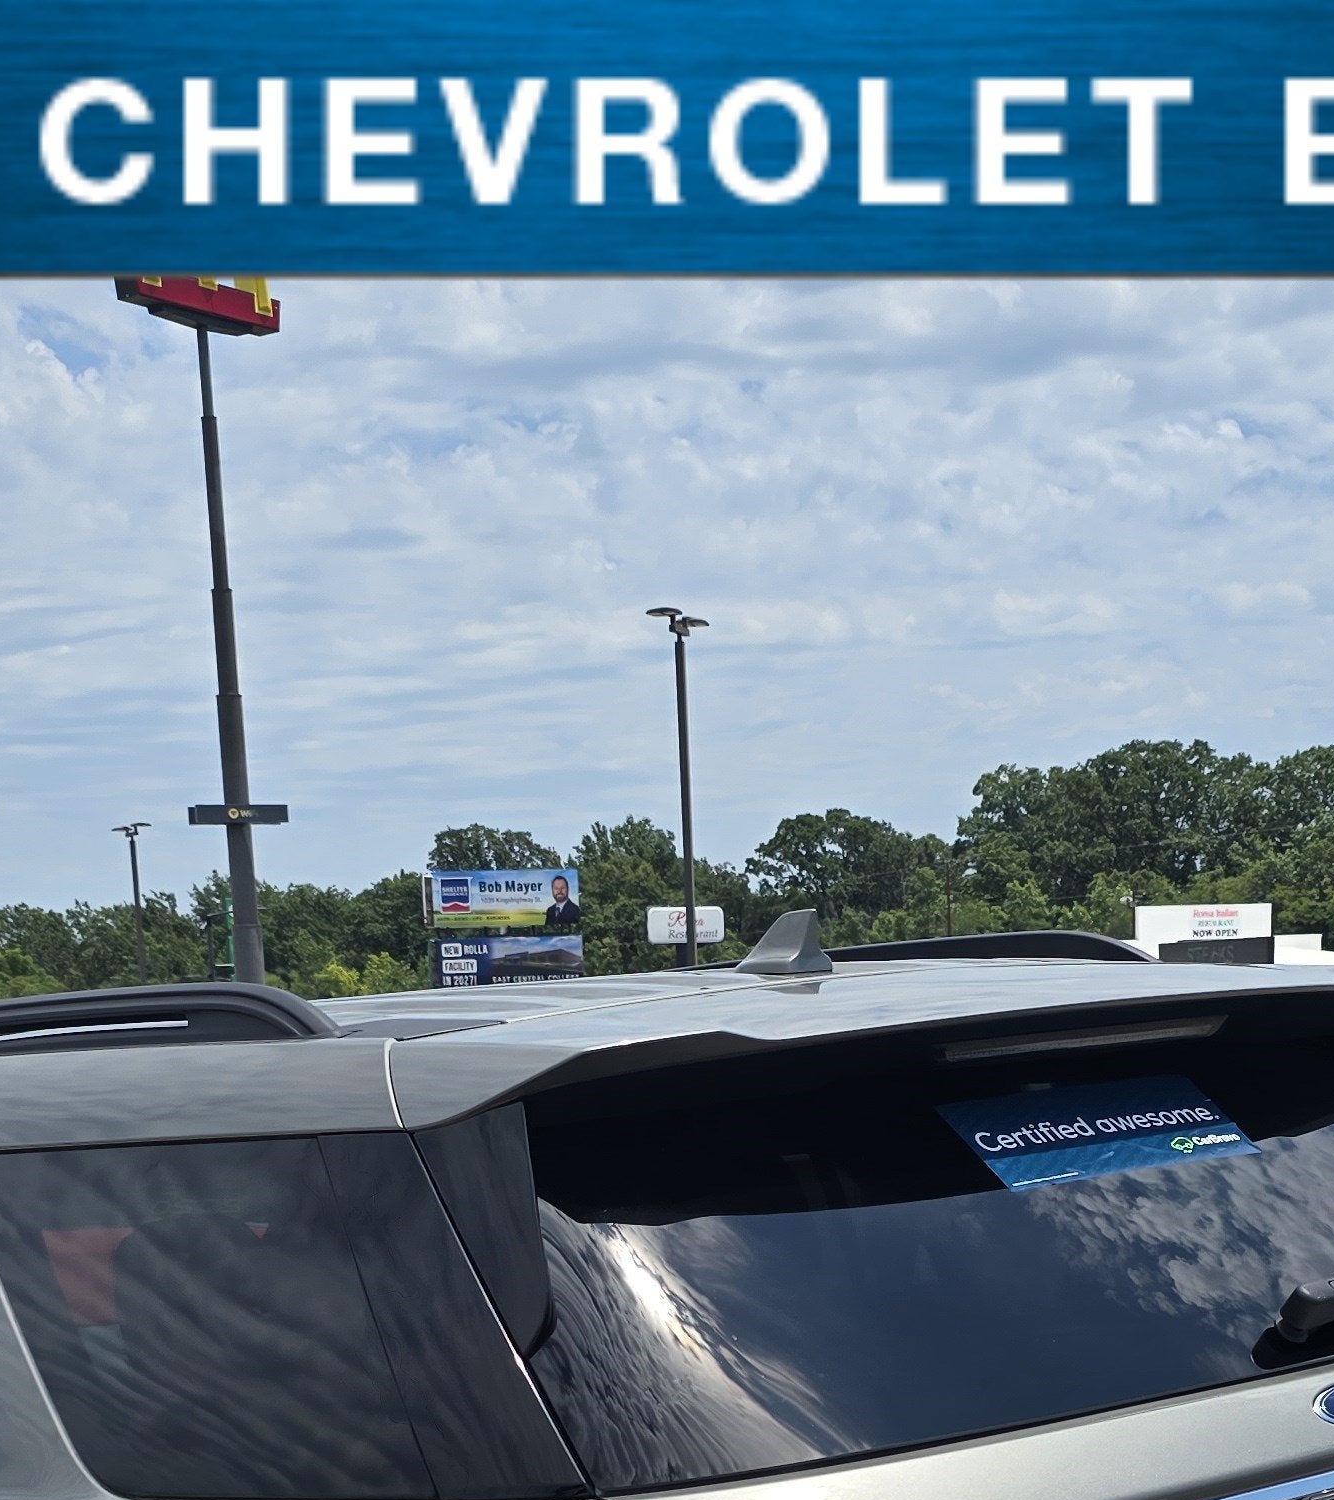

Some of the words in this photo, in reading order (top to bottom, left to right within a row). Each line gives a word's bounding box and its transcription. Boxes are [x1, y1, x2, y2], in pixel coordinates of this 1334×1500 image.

[441, 885, 468, 893] SHELTER
[478, 880, 502, 893] Bob
[505, 879, 543, 895] Mayer
[1192, 929, 1213, 938] NOW
[1215, 928, 1239, 937] OPEN
[443, 945, 461, 955] NEW
[463, 944, 489, 955] ROLLA
[444, 961, 476, 972] FACILITY
[492, 975, 512, 984] EAST
[513, 974, 545, 983] CENTRAL
[973, 1116, 1096, 1154] Certified
[1096, 1104, 1221, 1136] awesome.
